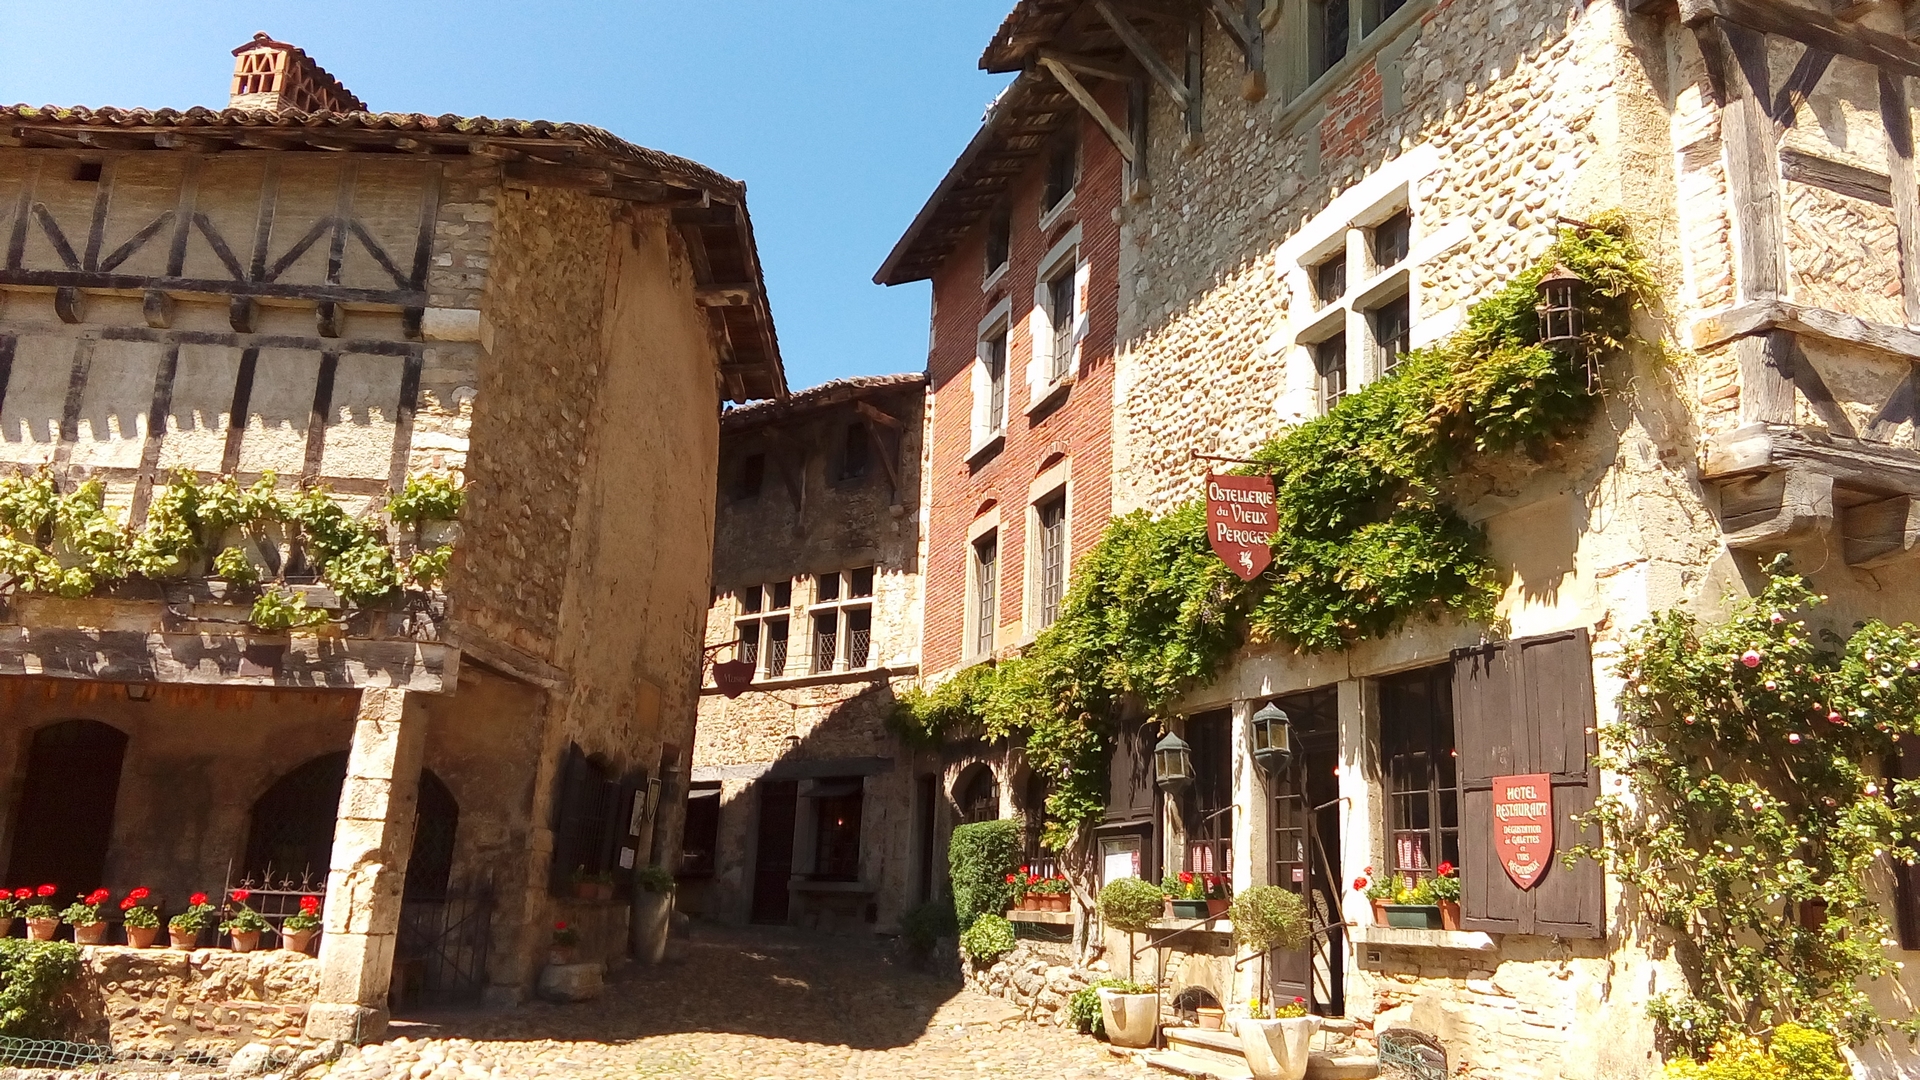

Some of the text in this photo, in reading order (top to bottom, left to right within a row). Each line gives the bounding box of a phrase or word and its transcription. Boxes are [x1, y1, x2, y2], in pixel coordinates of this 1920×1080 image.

[1209, 482, 1273, 508] OSTELLERIE
[1216, 503, 1268, 524] du VIEUX
[1506, 786, 1537, 800] HOTEL
[1495, 803, 1548, 821] RESTAURANT
